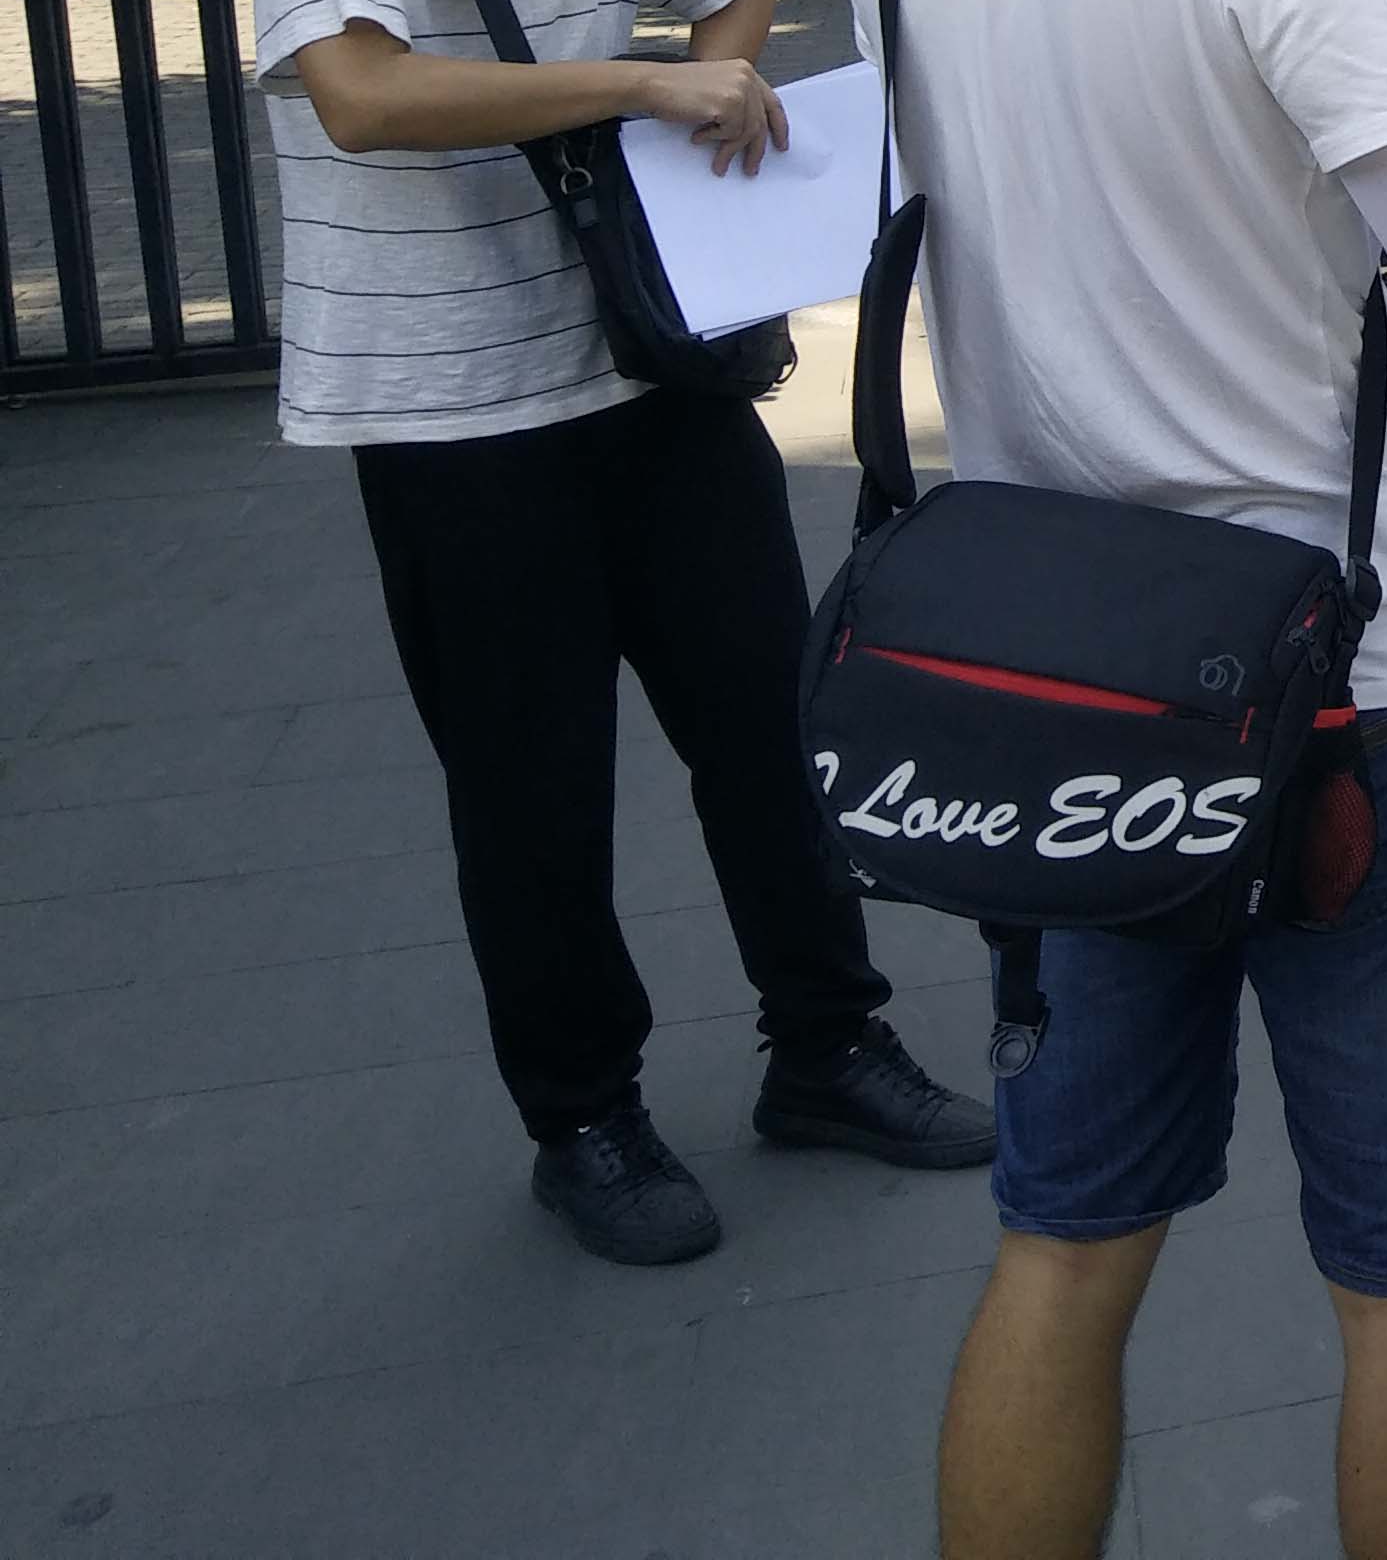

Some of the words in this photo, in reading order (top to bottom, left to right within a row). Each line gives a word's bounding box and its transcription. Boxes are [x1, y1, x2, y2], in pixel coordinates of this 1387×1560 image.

[838, 759, 1021, 847] Love
[1035, 773, 1262, 859] EOS
[1247, 879, 1266, 915] Canon
